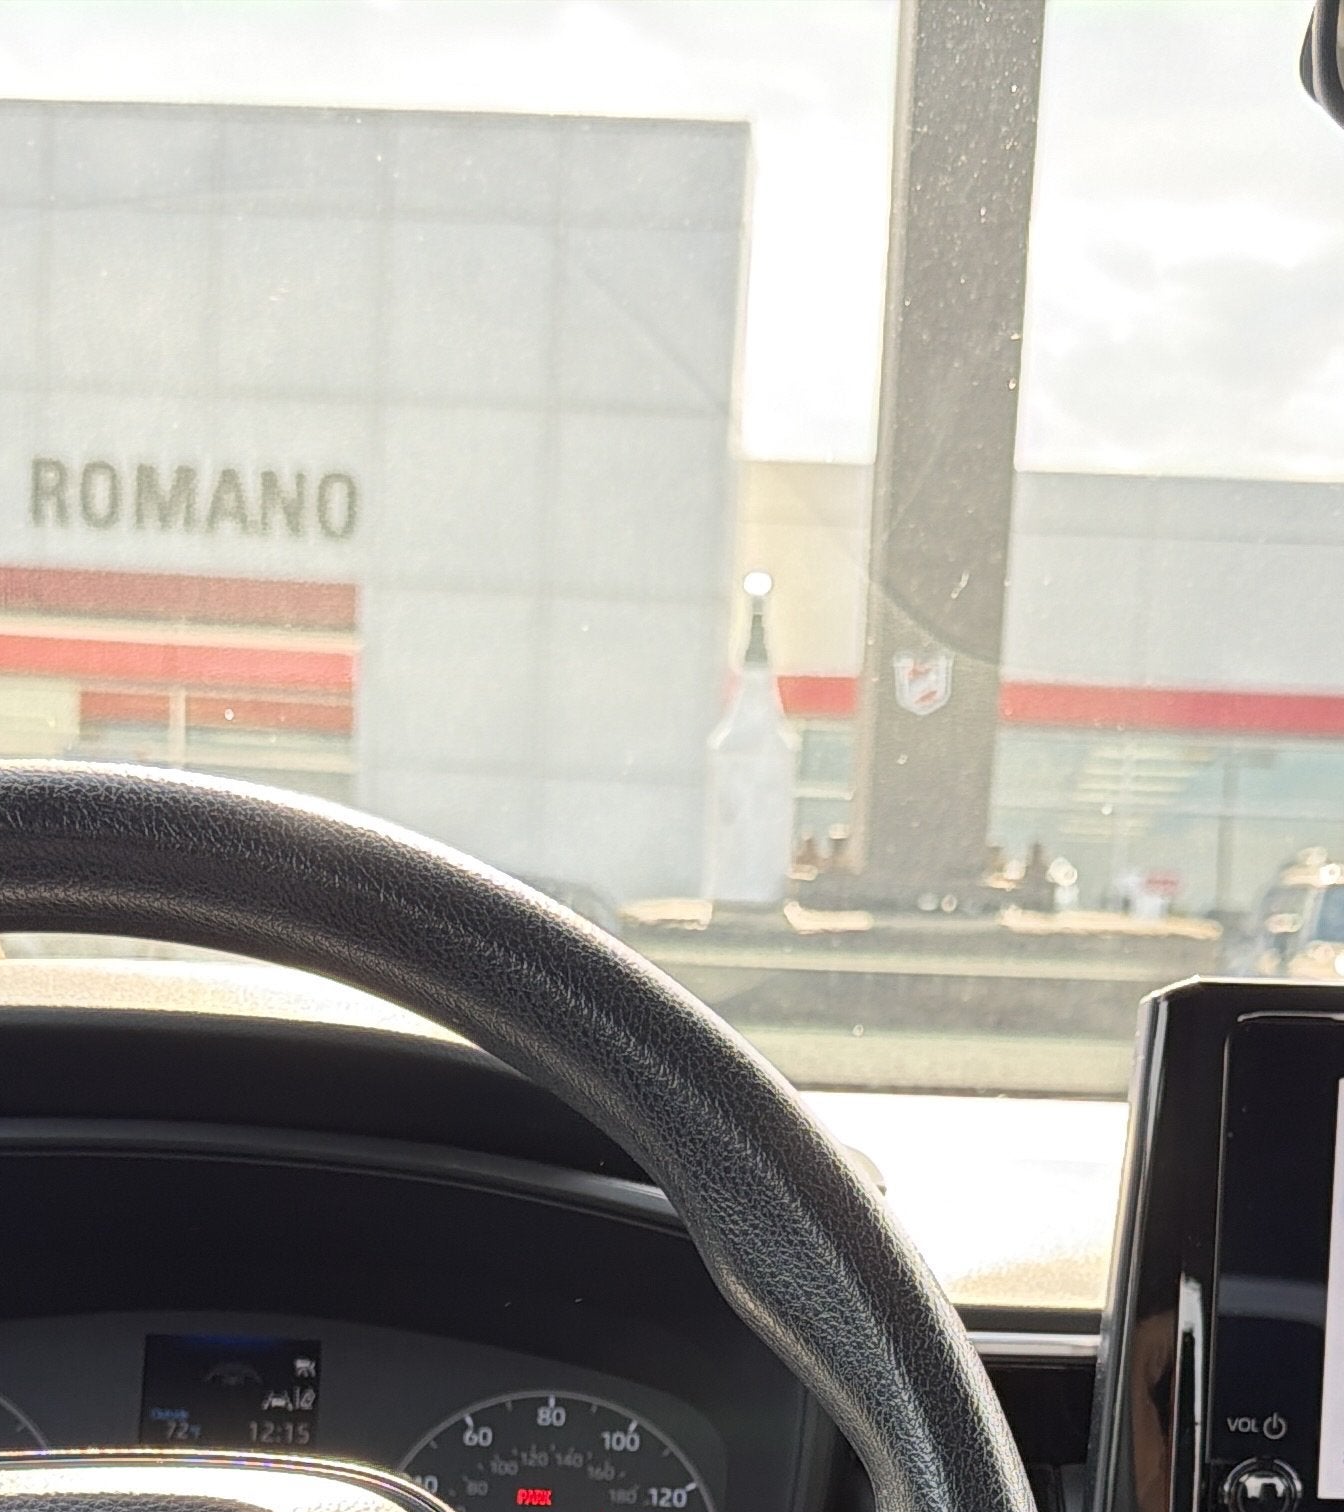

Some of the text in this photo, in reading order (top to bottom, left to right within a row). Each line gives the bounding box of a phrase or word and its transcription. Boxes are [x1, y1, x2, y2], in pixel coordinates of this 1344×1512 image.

[30, 458, 357, 539] ROMANO
[536, 1405, 566, 1427] 80
[1226, 1417, 1258, 1432] VOL
[249, 1420, 310, 1443] 12:15
[462, 1426, 493, 1447] 60
[600, 1430, 640, 1452] 100
[649, 1487, 688, 1508] 120
